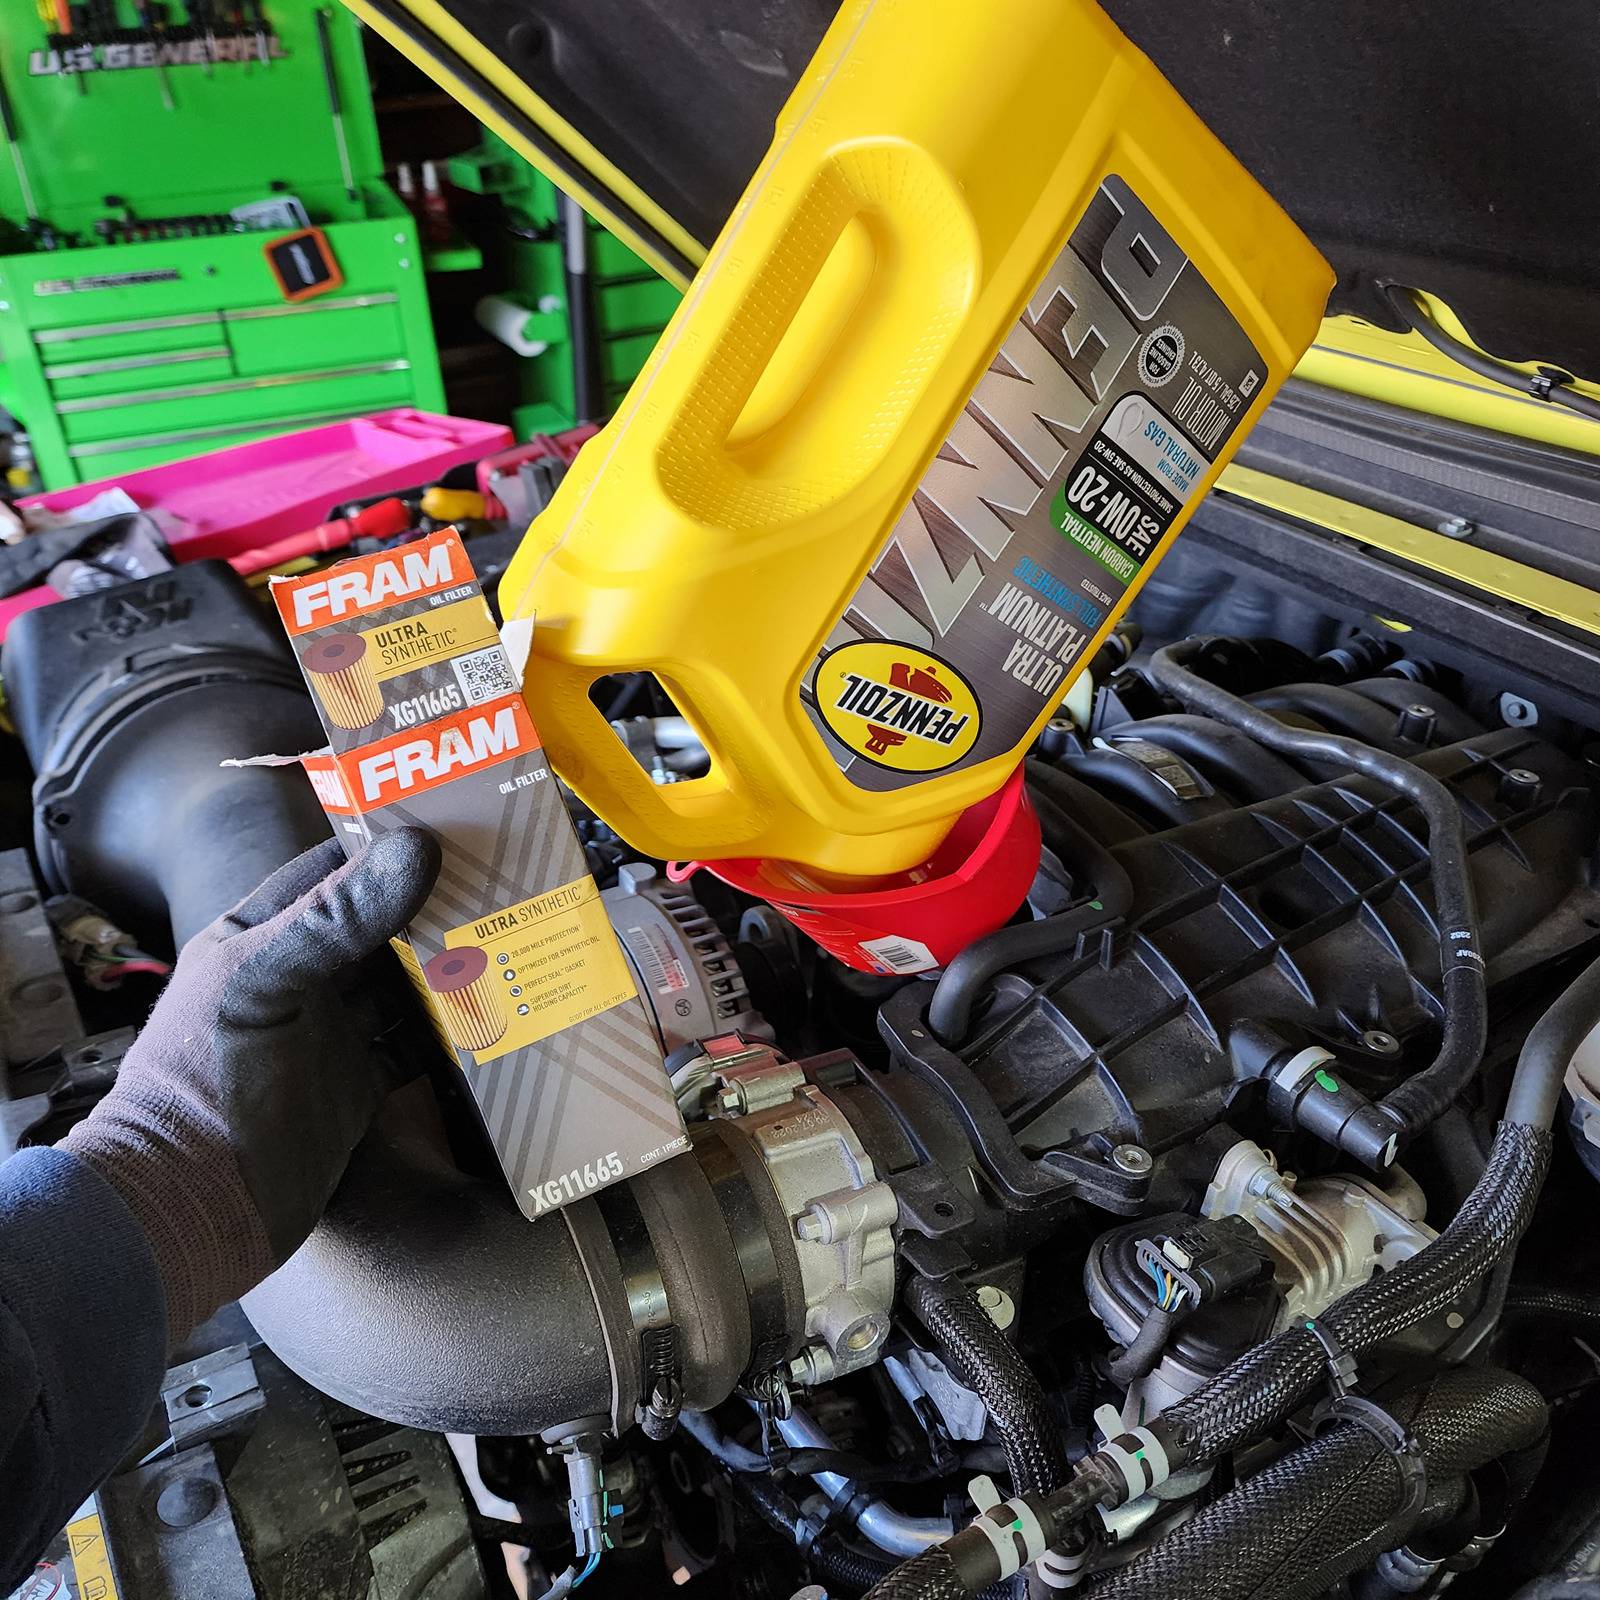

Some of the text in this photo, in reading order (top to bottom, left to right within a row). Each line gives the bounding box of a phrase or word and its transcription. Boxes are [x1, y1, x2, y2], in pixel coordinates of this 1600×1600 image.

[1149, 346, 1171, 370] GASOLINE
[1156, 338, 1176, 360] ENGINES
[1149, 361, 1160, 374] FOR
[1220, 384, 1233, 403] GAL
[1172, 376, 1231, 450] MOTOR OIL
[1144, 421, 1200, 480] NATURAL GAS
[1094, 440, 1174, 514] SAME PROTECTION AS SAE 5W-20
[1158, 458, 1189, 492] MADE FROM
[1068, 466, 1160, 556] SAE 0W-20
[1060, 512, 1134, 578] CARBON NEUTRAL
[292, 544, 454, 627] FRAM
[429, 585, 473, 606] OIL FILTER
[1012, 556, 1102, 628] FULL SYNTHETIC
[375, 621, 428, 648] ULTRA
[382, 630, 455, 665] SYNTHETIC
[1002, 638, 1063, 696] ULTRA
[388, 684, 461, 728] XG11665
[836, 674, 969, 746] PENNZOIL
[359, 707, 520, 802] FRAM
[498, 768, 548, 795] OIL FILTER
[475, 887, 580, 939] ULTRA SYNTHETIC
[512, 946, 530, 958] 20,000
[531, 940, 544, 952] MILE
[518, 936, 600, 974] OPTIMIZED FOR SYNTHETIC OIL
[524, 975, 549, 990] PERFECT
[565, 959, 586, 972] GASKET
[530, 982, 572, 1004] SUPERIOR DIRT
[532, 998, 558, 1012] HOLDING
[568, 1013, 582, 1022] GOOD
[583, 1008, 593, 1016] FOR
[593, 1003, 603, 1011] ALL
[612, 992, 627, 1002] TYPES
[528, 1152, 624, 1212] XG11665
[640, 1149, 663, 1163] CONT.
[666, 1135, 688, 1152] PIECE
